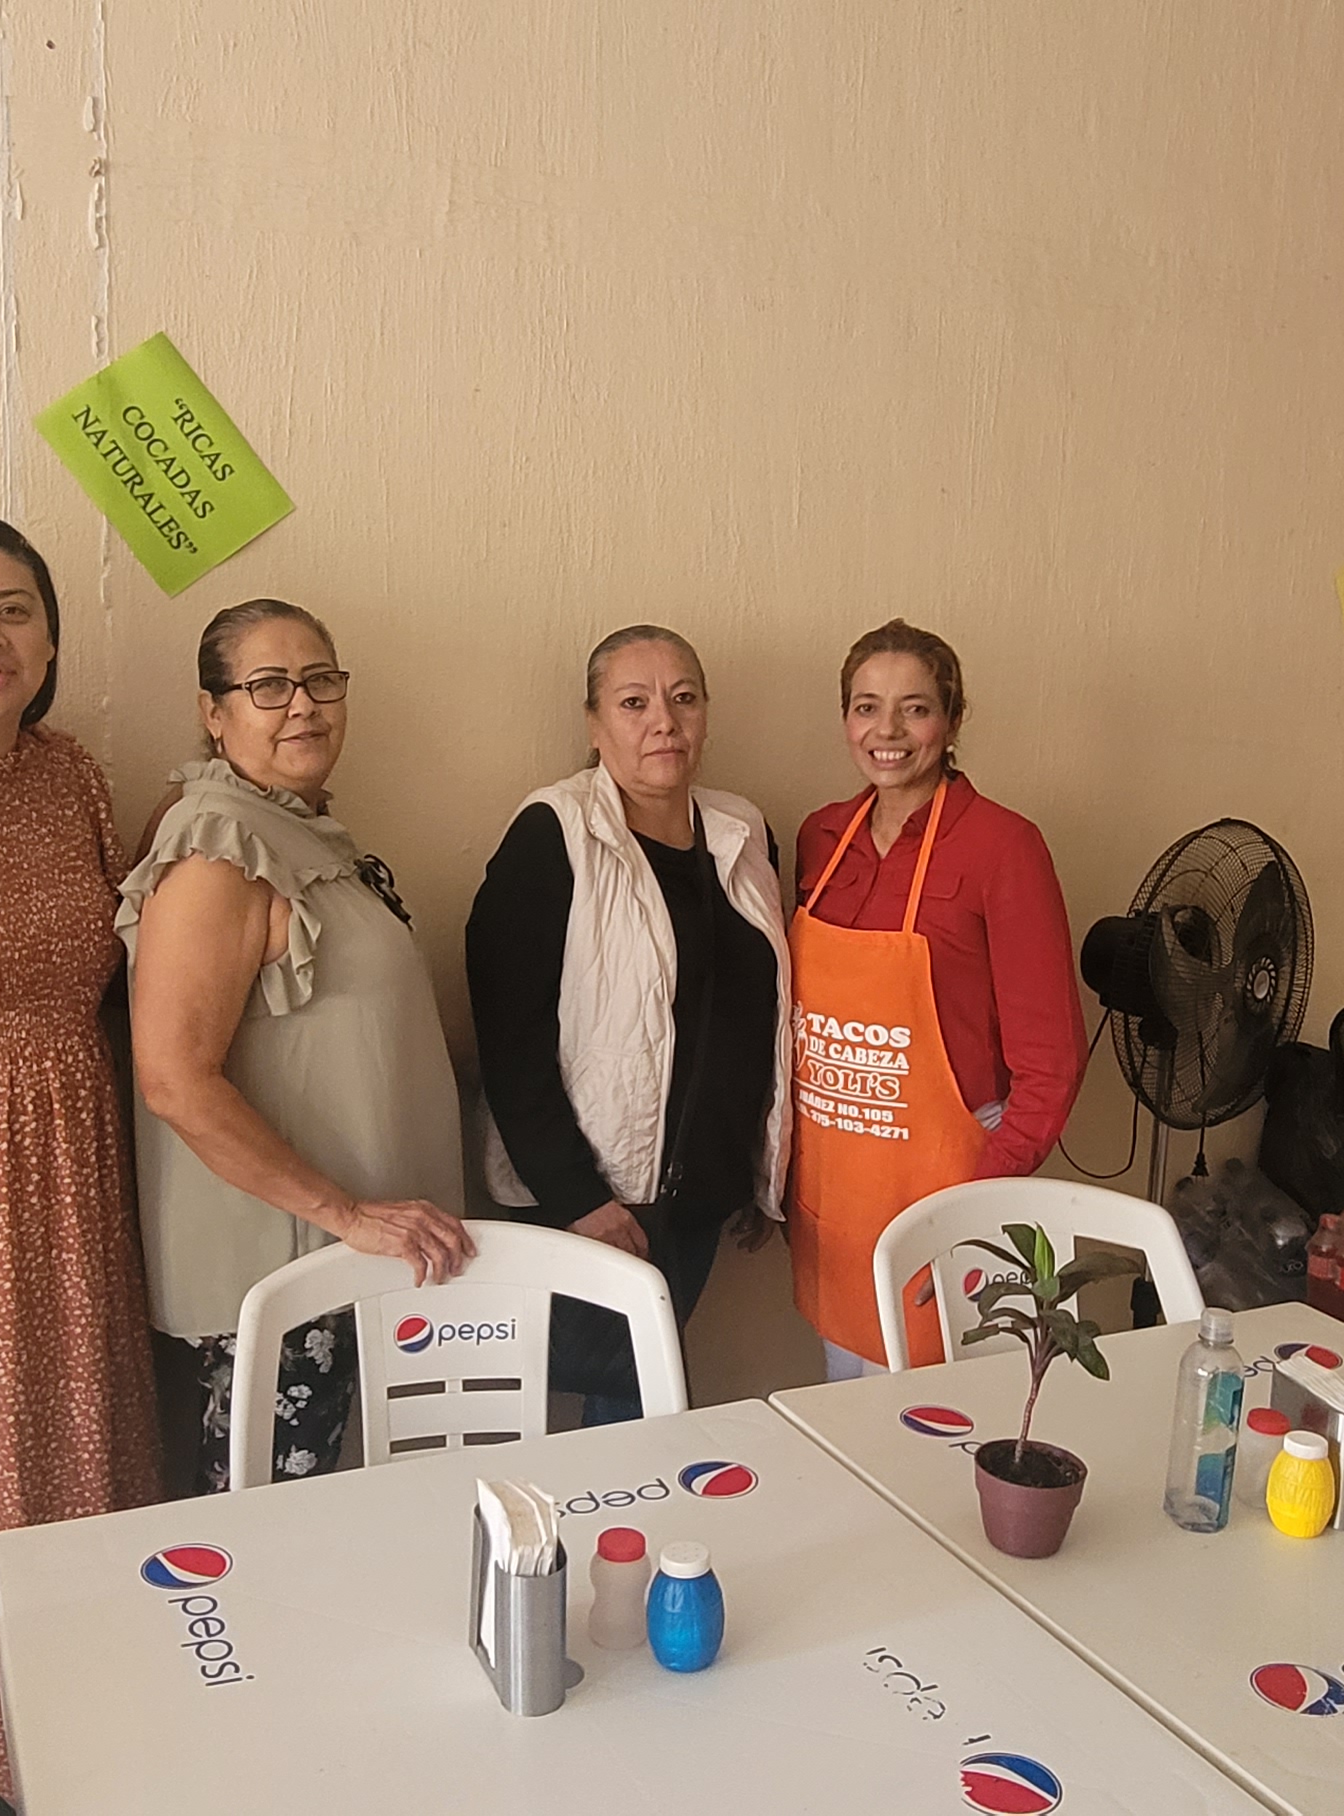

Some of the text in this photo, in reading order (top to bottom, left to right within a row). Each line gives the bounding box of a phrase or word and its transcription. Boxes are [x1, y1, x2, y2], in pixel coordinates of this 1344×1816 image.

[122, 405, 215, 519] COCADAS
[807, 1012, 911, 1048] TACOS
[809, 1035, 910, 1070] DE CABEZA
[808, 1059, 900, 1101] YOLI'S
[438, 1318, 517, 1347] pepsi
[555, 1477, 670, 1518] pep
[167, 1595, 255, 1687] pepsi
